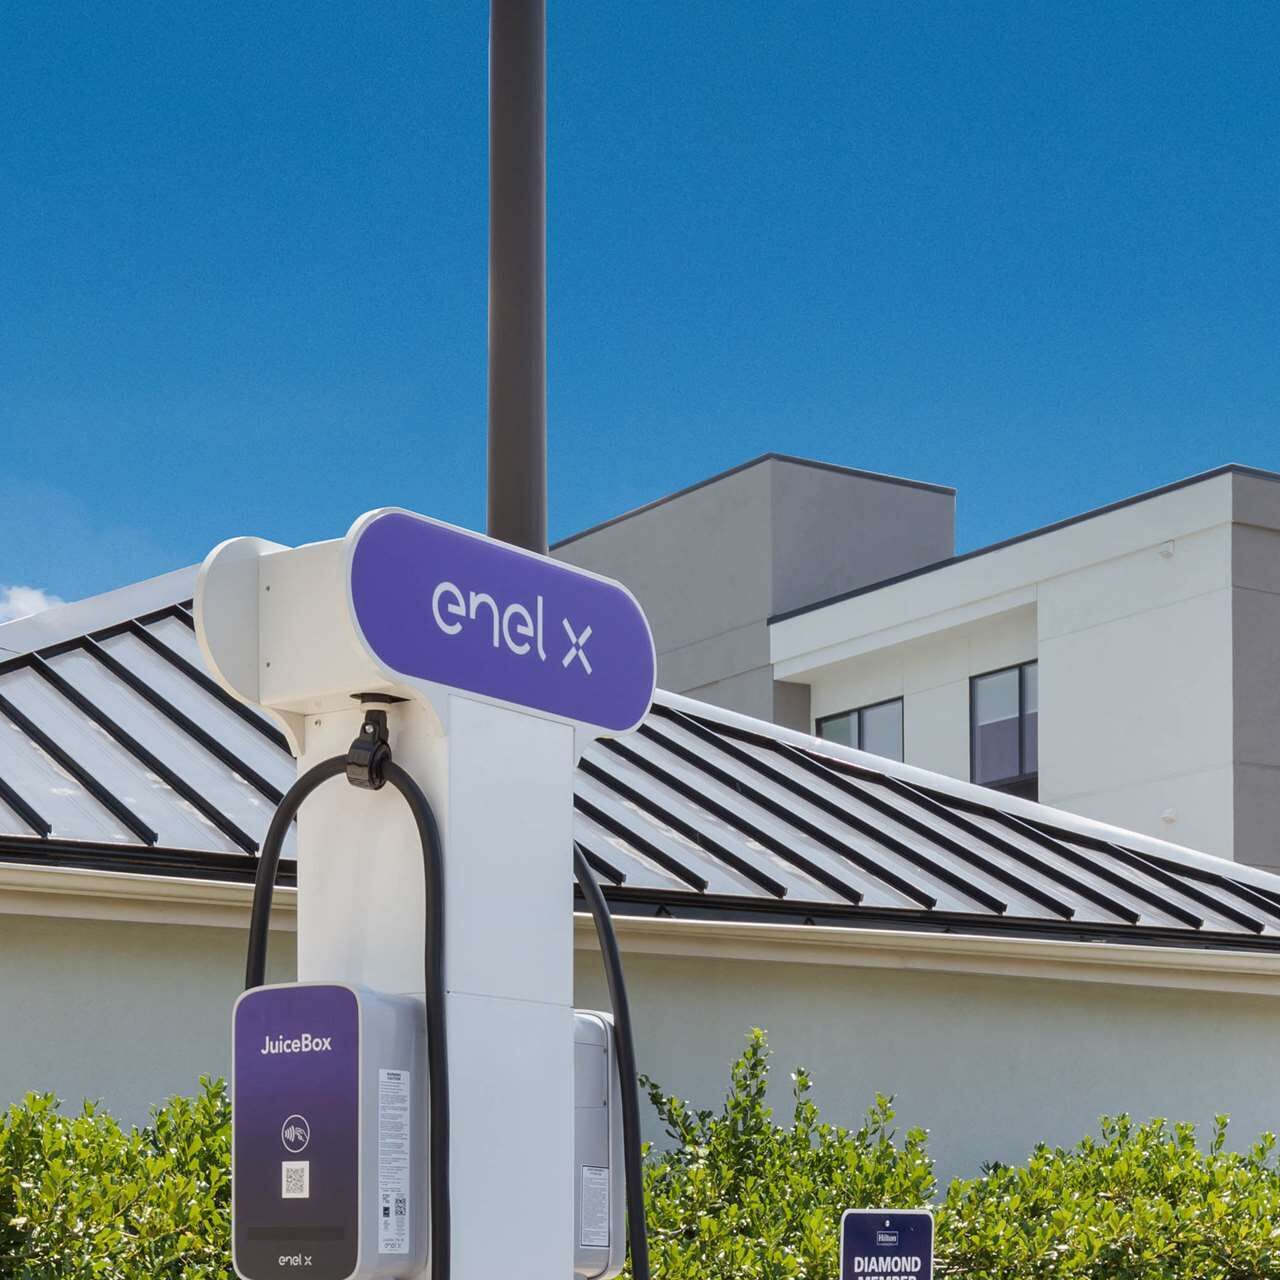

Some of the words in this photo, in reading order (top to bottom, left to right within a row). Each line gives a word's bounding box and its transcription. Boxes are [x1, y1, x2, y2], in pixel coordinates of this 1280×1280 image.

[432, 581, 547, 661] enel
[561, 617, 593, 676] x
[260, 1033, 332, 1055] JuiceBox
[278, 1253, 302, 1266] enel
[304, 1255, 312, 1267] x
[853, 1256, 922, 1273] DIAMOND
